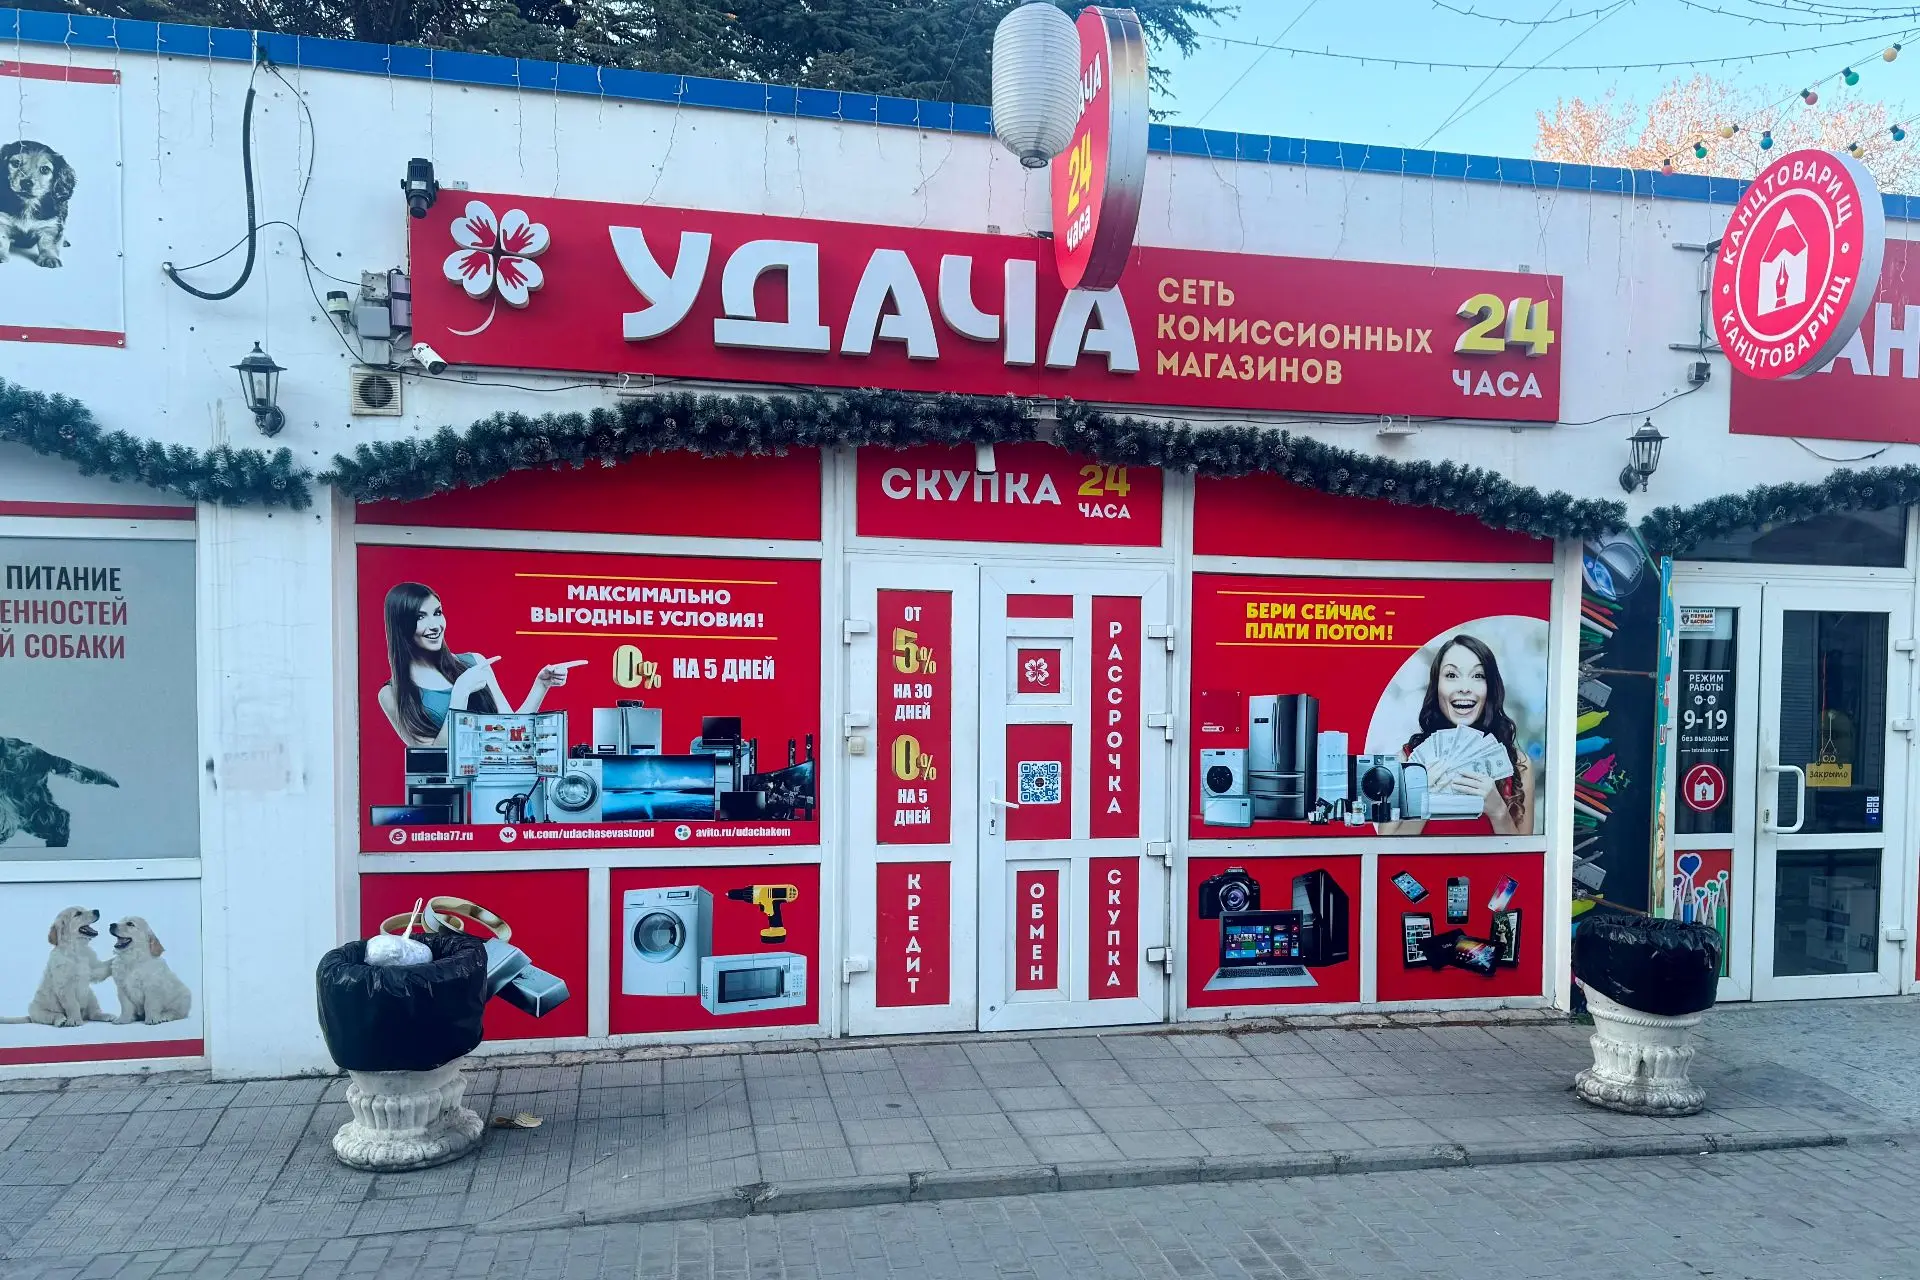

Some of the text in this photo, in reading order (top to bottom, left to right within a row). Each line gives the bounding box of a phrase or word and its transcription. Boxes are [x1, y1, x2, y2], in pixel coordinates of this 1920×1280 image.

[1067, 128, 1092, 216] 24
[1722, 160, 1853, 265] КАНЦТОВАРИЩ
[1066, 204, 1091, 253] часа
[608, 225, 1140, 374] УДАЧА
[1157, 277, 1235, 307] СЕТЬ
[1157, 313, 1433, 354] КОМИССИОННЫХ
[1454, 292, 1555, 357] 24
[1721, 274, 1852, 371] КАНЦТОВАРИЩ
[1156, 349, 1342, 385] МАГАЗИНОВ
[1451, 368, 1543, 400] ЧАСА
[881, 467, 1062, 505] СКУПКА
[1077, 464, 1131, 497] 24
[1078, 502, 1131, 519] ЧАСА
[6, 565, 122, 592] ПИТАНИЕ
[567, 584, 731, 605] МАКСИМАЛЬНО
[530, 606, 765, 628] ВЫГОДНЫЕ УСЛОВИЯ!
[904, 606, 922, 622] ОТ
[1246, 602, 1296, 619] БЕРИ
[1300, 600, 1377, 621] СЕЙЧАС
[1245, 622, 1393, 641] ПЛАТИ ПОТОМ!
[24, 633, 125, 659] СОБАКИ
[892, 626, 937, 675] 5%
[612, 644, 776, 690] 0% НА 5 ДНЕЙ
[1689, 674, 1724, 682] РЕЖИМ
[893, 683, 933, 699] НА 30
[1689, 683, 1724, 692] РАБОТЫ
[894, 702, 931, 722] ДНЕЙ
[1106, 621, 1123, 814] РАССРОЧКА
[1683, 709, 1728, 730] 9-19
[1681, 734, 1693, 742] без
[892, 734, 937, 781] 0%
[1809, 770, 1849, 781] закрыто
[897, 788, 928, 804] НА 5
[893, 807, 931, 827] ДНЕЙ
[411, 830, 474, 842] udacha77.ru
[522, 827, 655, 840] vk.com/udachasevastopol
[695, 826, 791, 838] avito.ru/udachakom
[905, 873, 922, 994] КРЕДИТ
[1029, 883, 1045, 981] ОБМЕН
[1107, 869, 1122, 986] СКУПКА
